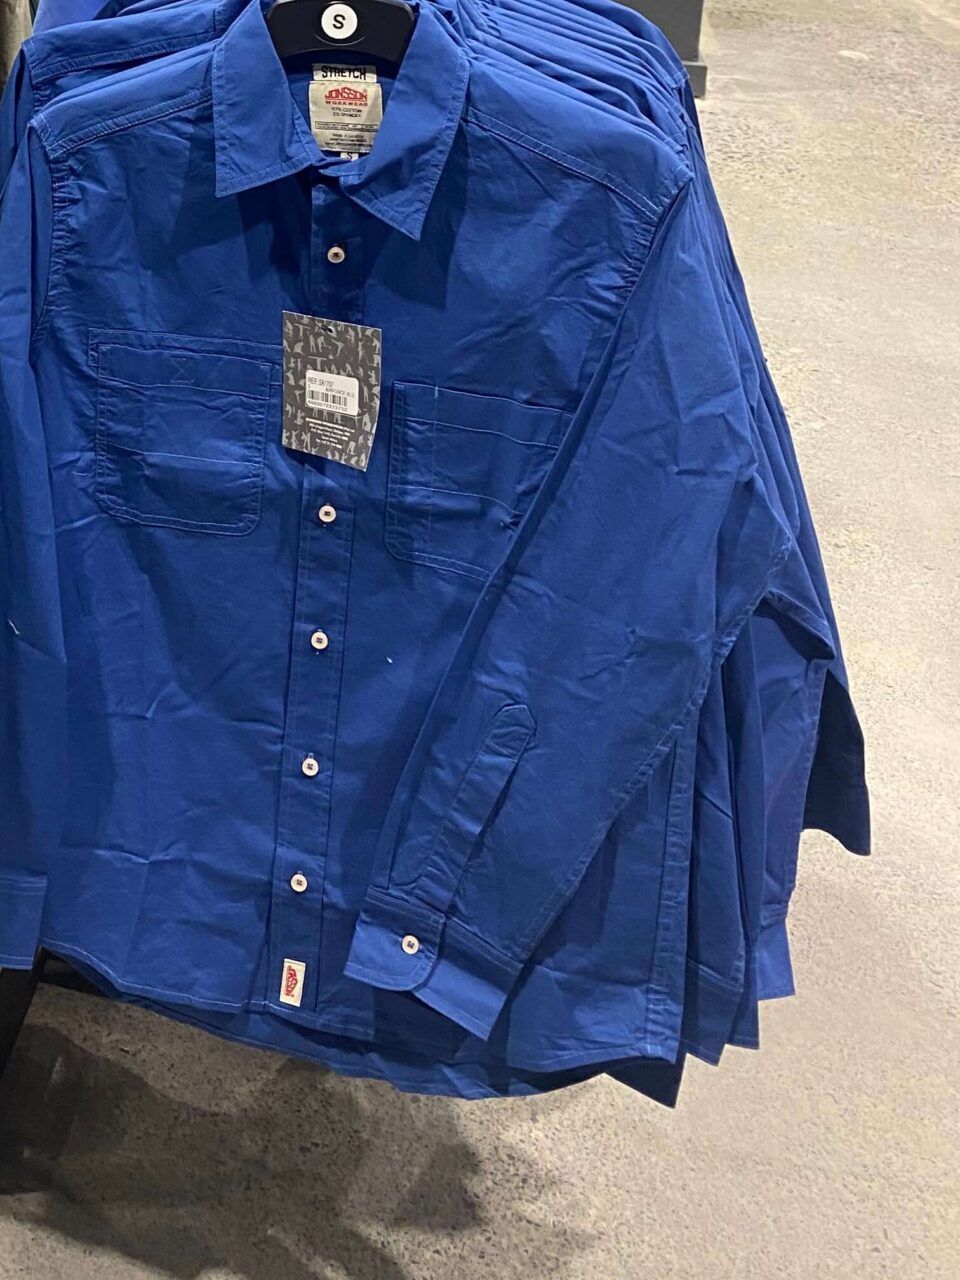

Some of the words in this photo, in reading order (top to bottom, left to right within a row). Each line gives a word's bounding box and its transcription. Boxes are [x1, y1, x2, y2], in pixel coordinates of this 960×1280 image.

[332, 14, 346, 29] S
[321, 65, 367, 80] STRETCH
[325, 86, 368, 101] JONSSON
